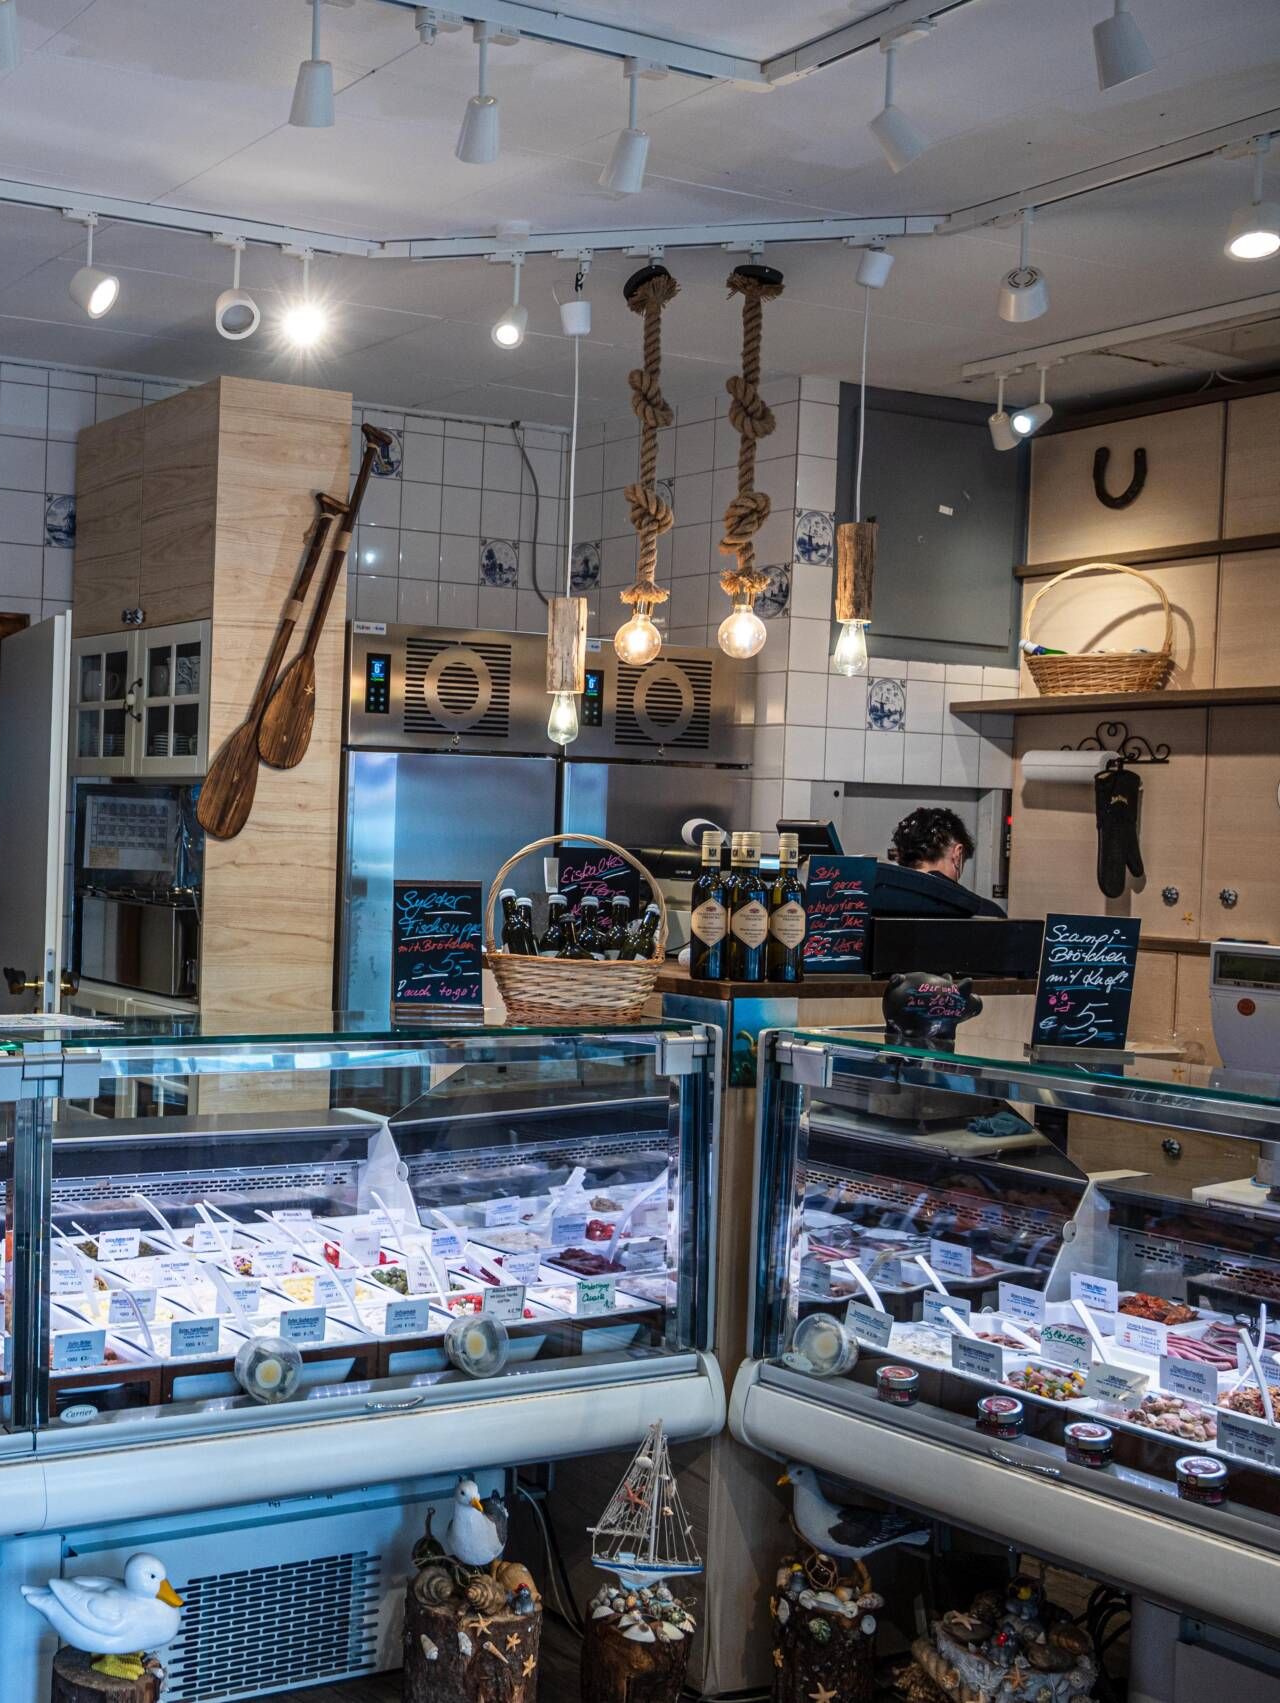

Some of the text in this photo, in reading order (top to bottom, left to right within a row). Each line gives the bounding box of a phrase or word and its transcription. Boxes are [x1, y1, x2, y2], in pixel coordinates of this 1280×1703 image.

[1048, 946, 1128, 965] Brötchen
[1045, 968, 1083, 984] mit
[65, 1407, 94, 1419] Carrier
